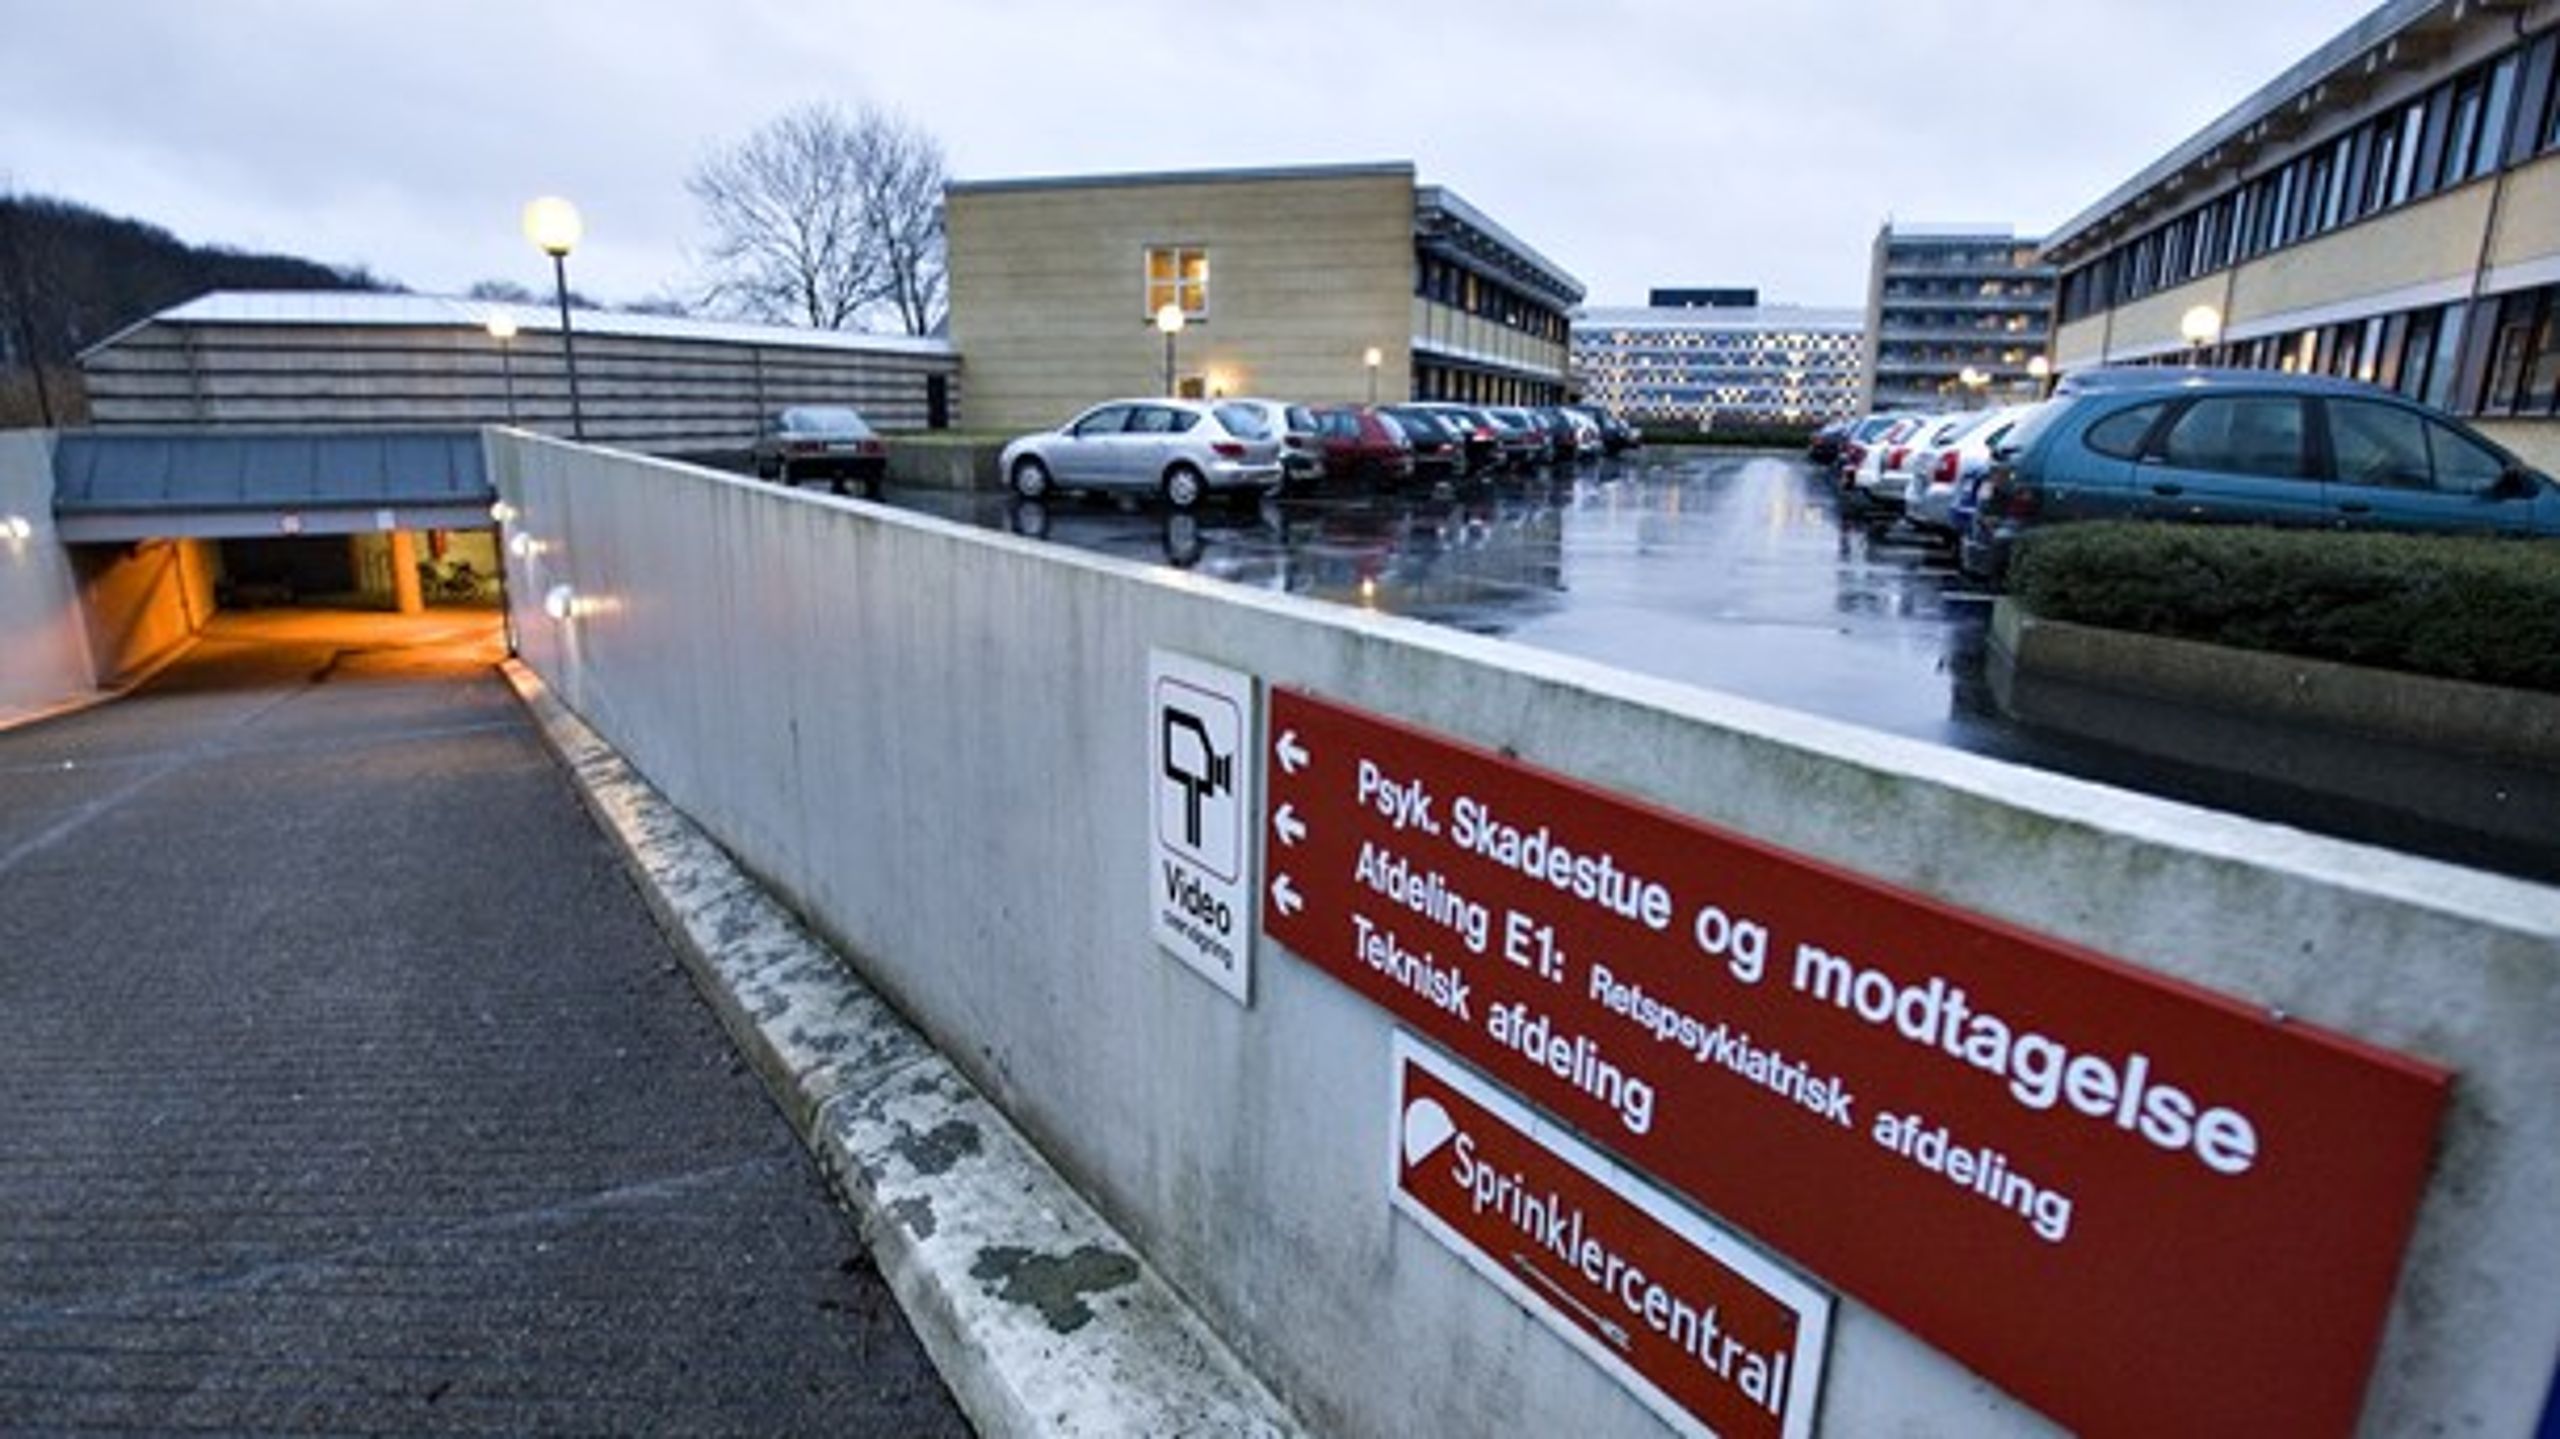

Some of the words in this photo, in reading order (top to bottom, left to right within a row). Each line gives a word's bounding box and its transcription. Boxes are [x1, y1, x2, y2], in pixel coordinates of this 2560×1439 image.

[1163, 860, 1232, 936] Video
[1352, 914, 1470, 1020] Teknisk
[1488, 1000, 1655, 1135] afdeling
[1358, 758, 1441, 836] Psyk.
[1452, 796, 1671, 930] Skadestue
[1695, 904, 1768, 983] og
[1794, 943, 2259, 1174] modtagelse
[1356, 841, 1488, 954] Afdeling
[1504, 911, 1565, 984] E1:
[1590, 963, 1854, 1128] Retspsykiatrisk
[1873, 1107, 2072, 1242] afdeling
[1452, 1131, 1789, 1415] Sprinklercentral
